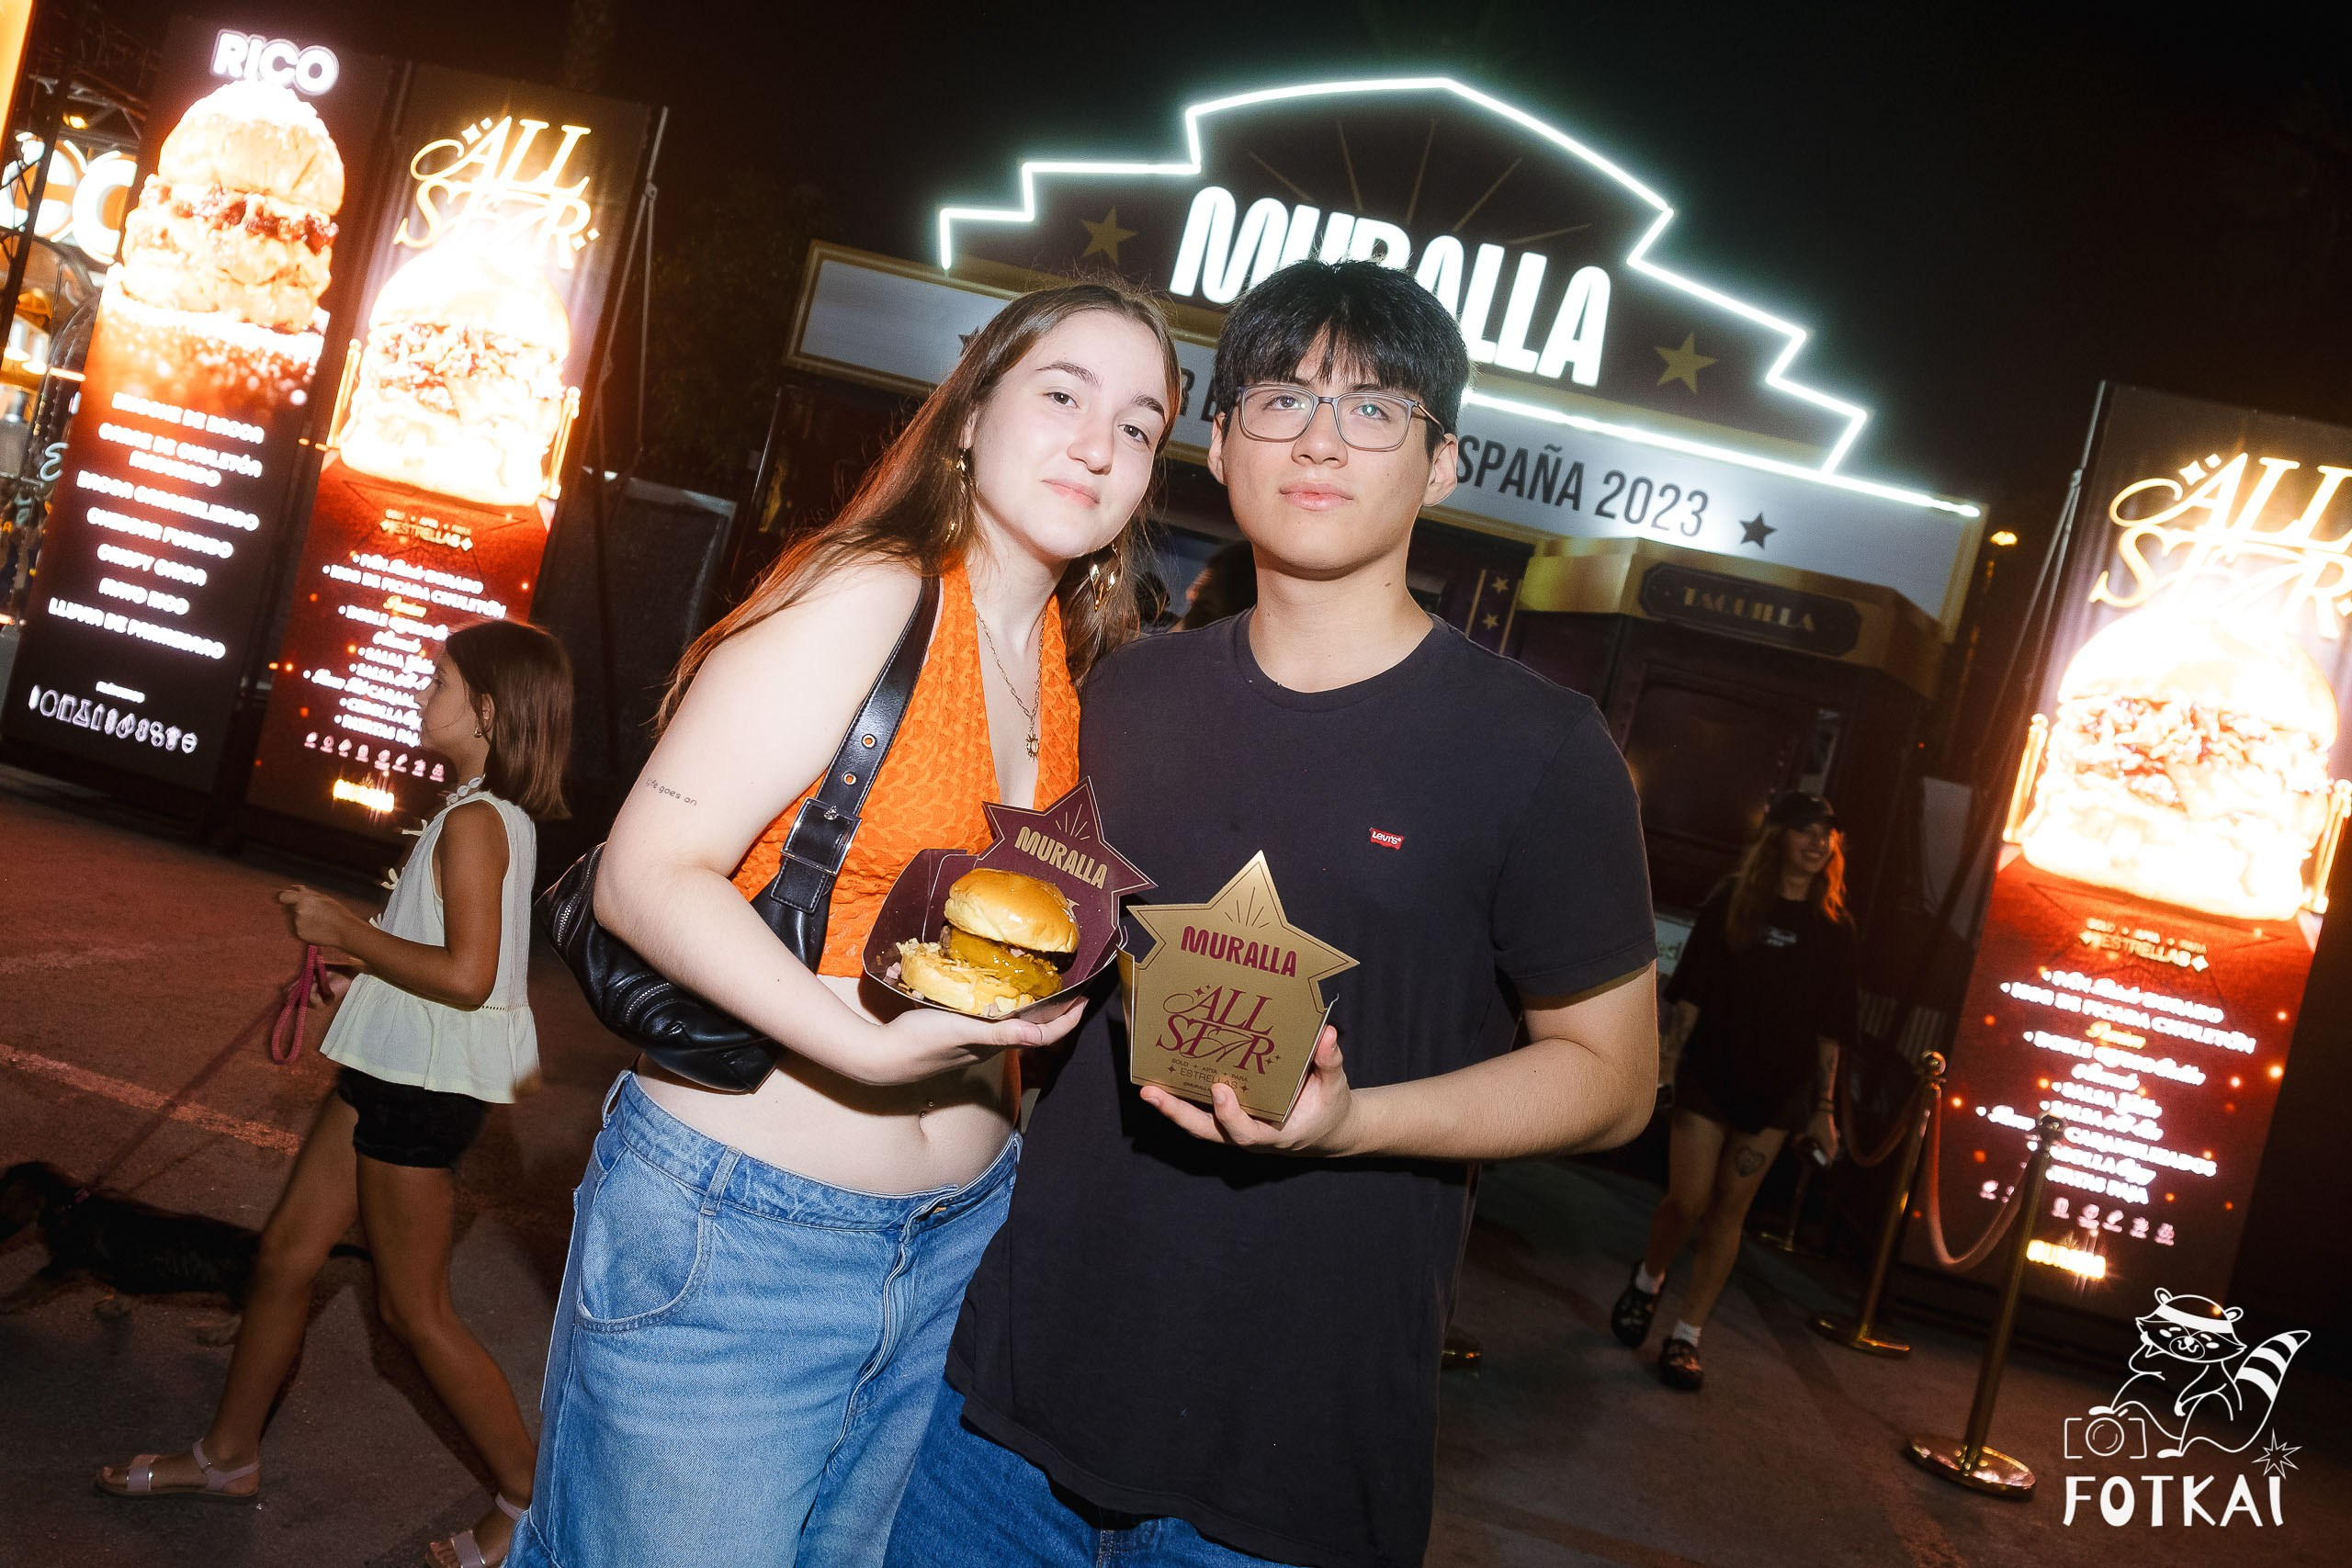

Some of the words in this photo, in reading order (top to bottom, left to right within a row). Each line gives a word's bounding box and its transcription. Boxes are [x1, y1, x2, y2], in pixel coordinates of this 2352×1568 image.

[212, 30, 337, 94] RICO
[411, 115, 592, 198] ALL
[1456, 434, 1586, 511] SPAÑA
[1594, 469, 1709, 537] 2023
[645, 777, 659, 789] life
[659, 785, 682, 799] goes
[684, 796, 697, 807] on
[1014, 826, 1108, 890] MURALLA
[1180, 925, 1297, 978] MURALLA
[1162, 985, 1273, 1036] ALL
